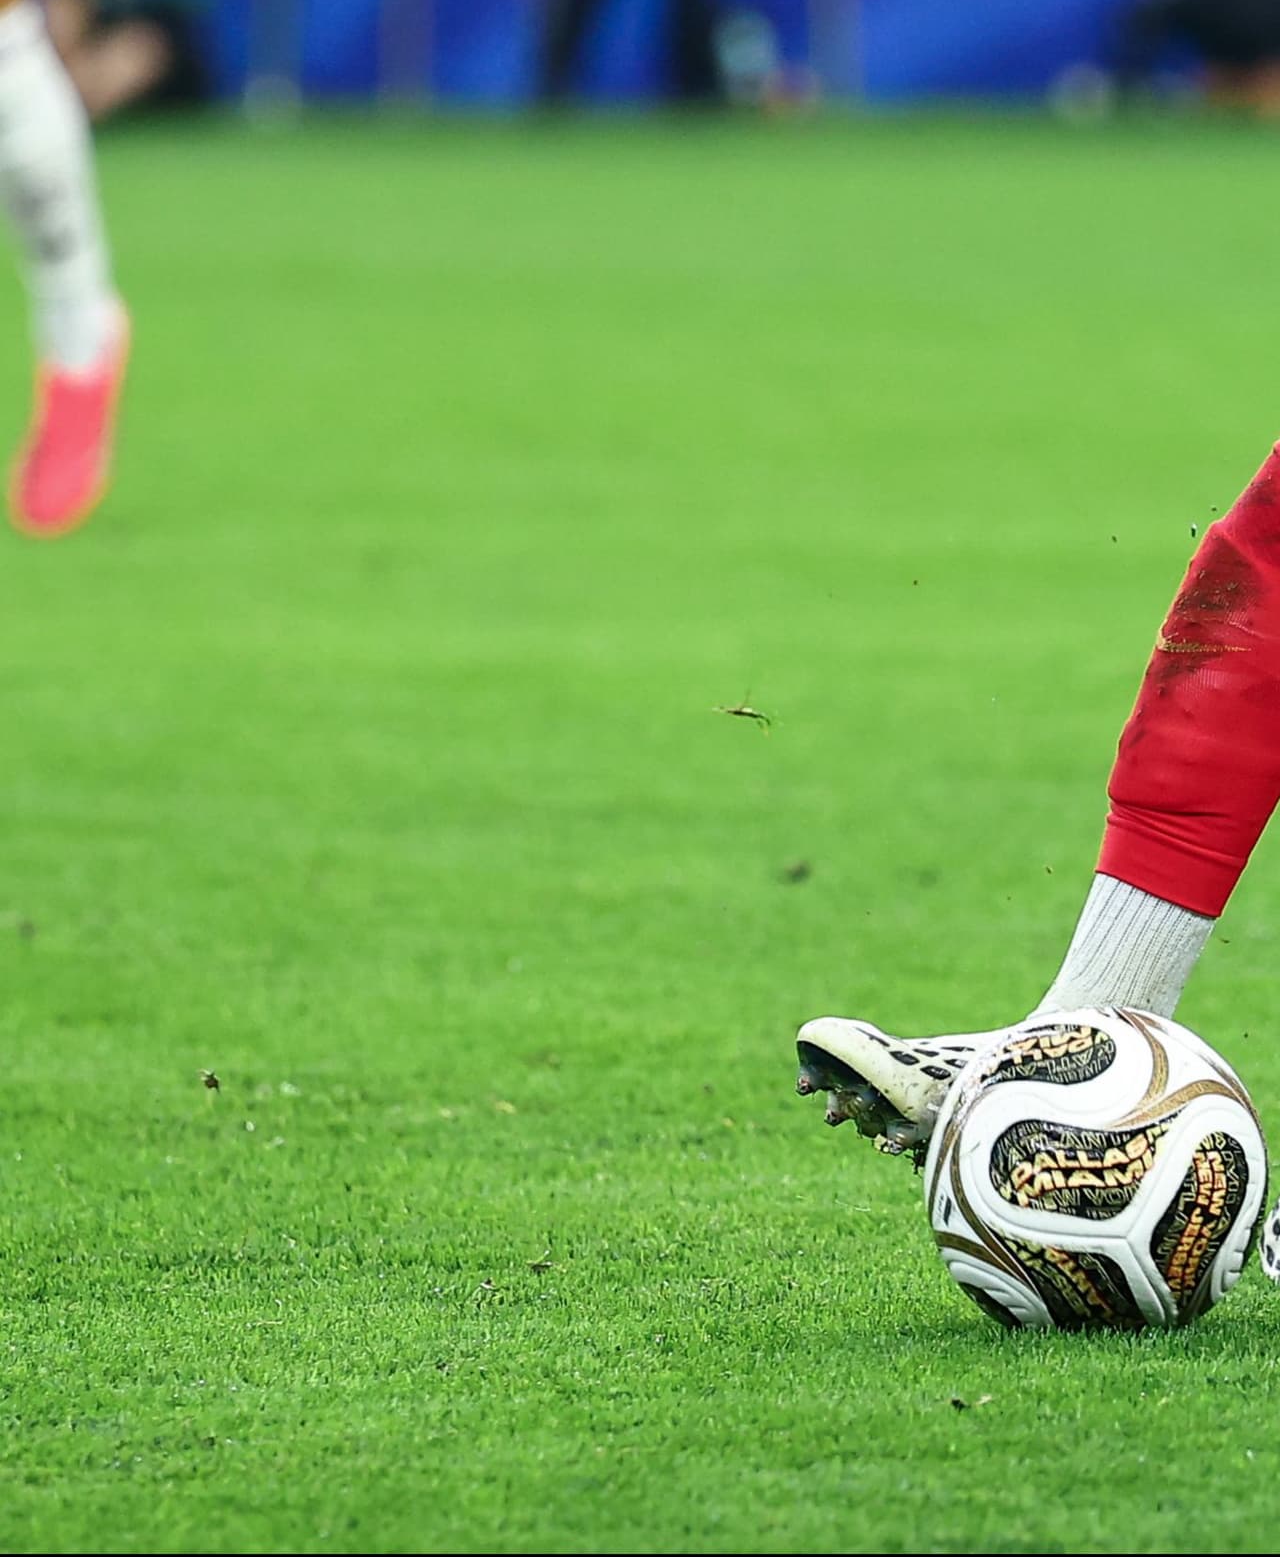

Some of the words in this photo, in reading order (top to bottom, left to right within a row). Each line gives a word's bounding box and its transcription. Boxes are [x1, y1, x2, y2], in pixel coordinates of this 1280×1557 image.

[1011, 1133, 1150, 1186] DALLAS
[1017, 1148, 1155, 1208] MIAMI
[1207, 1150, 1228, 1217] NEW
